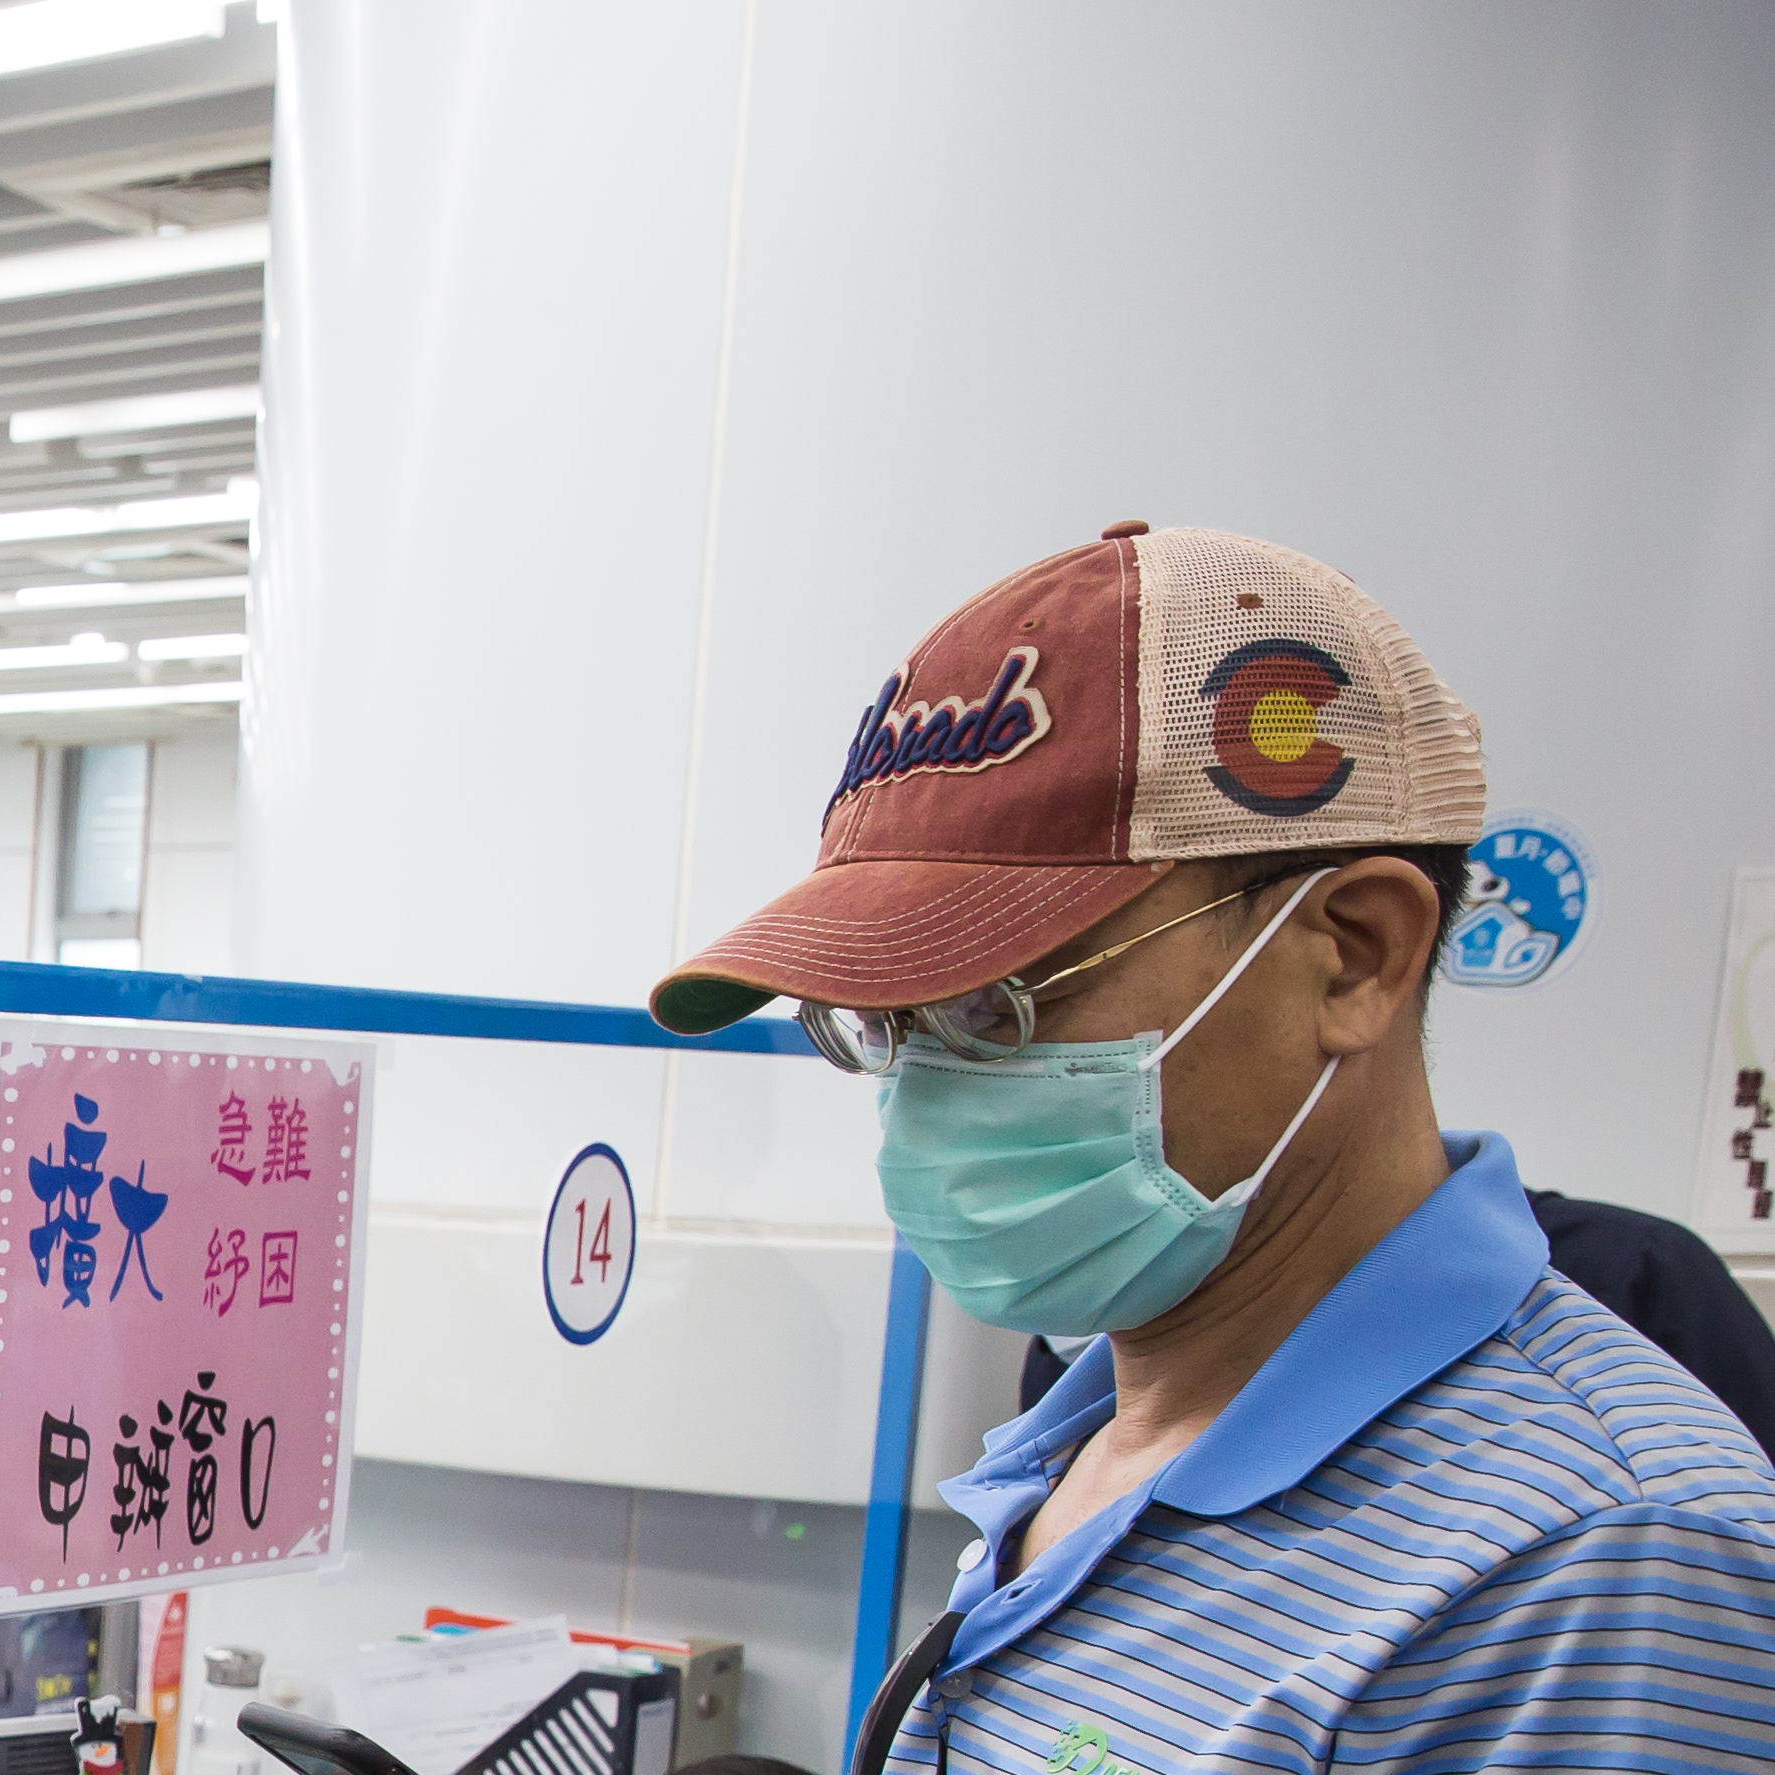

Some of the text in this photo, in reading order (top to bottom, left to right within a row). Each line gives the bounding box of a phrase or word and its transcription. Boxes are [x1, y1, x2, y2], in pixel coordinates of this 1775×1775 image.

[211, 1090, 311, 1187] 急難
[27, 1094, 169, 1309] 擴大
[569, 1197, 612, 1285] 14
[203, 1227, 299, 1318] 紓困
[38, 1372, 277, 1564] 申辦窗口
